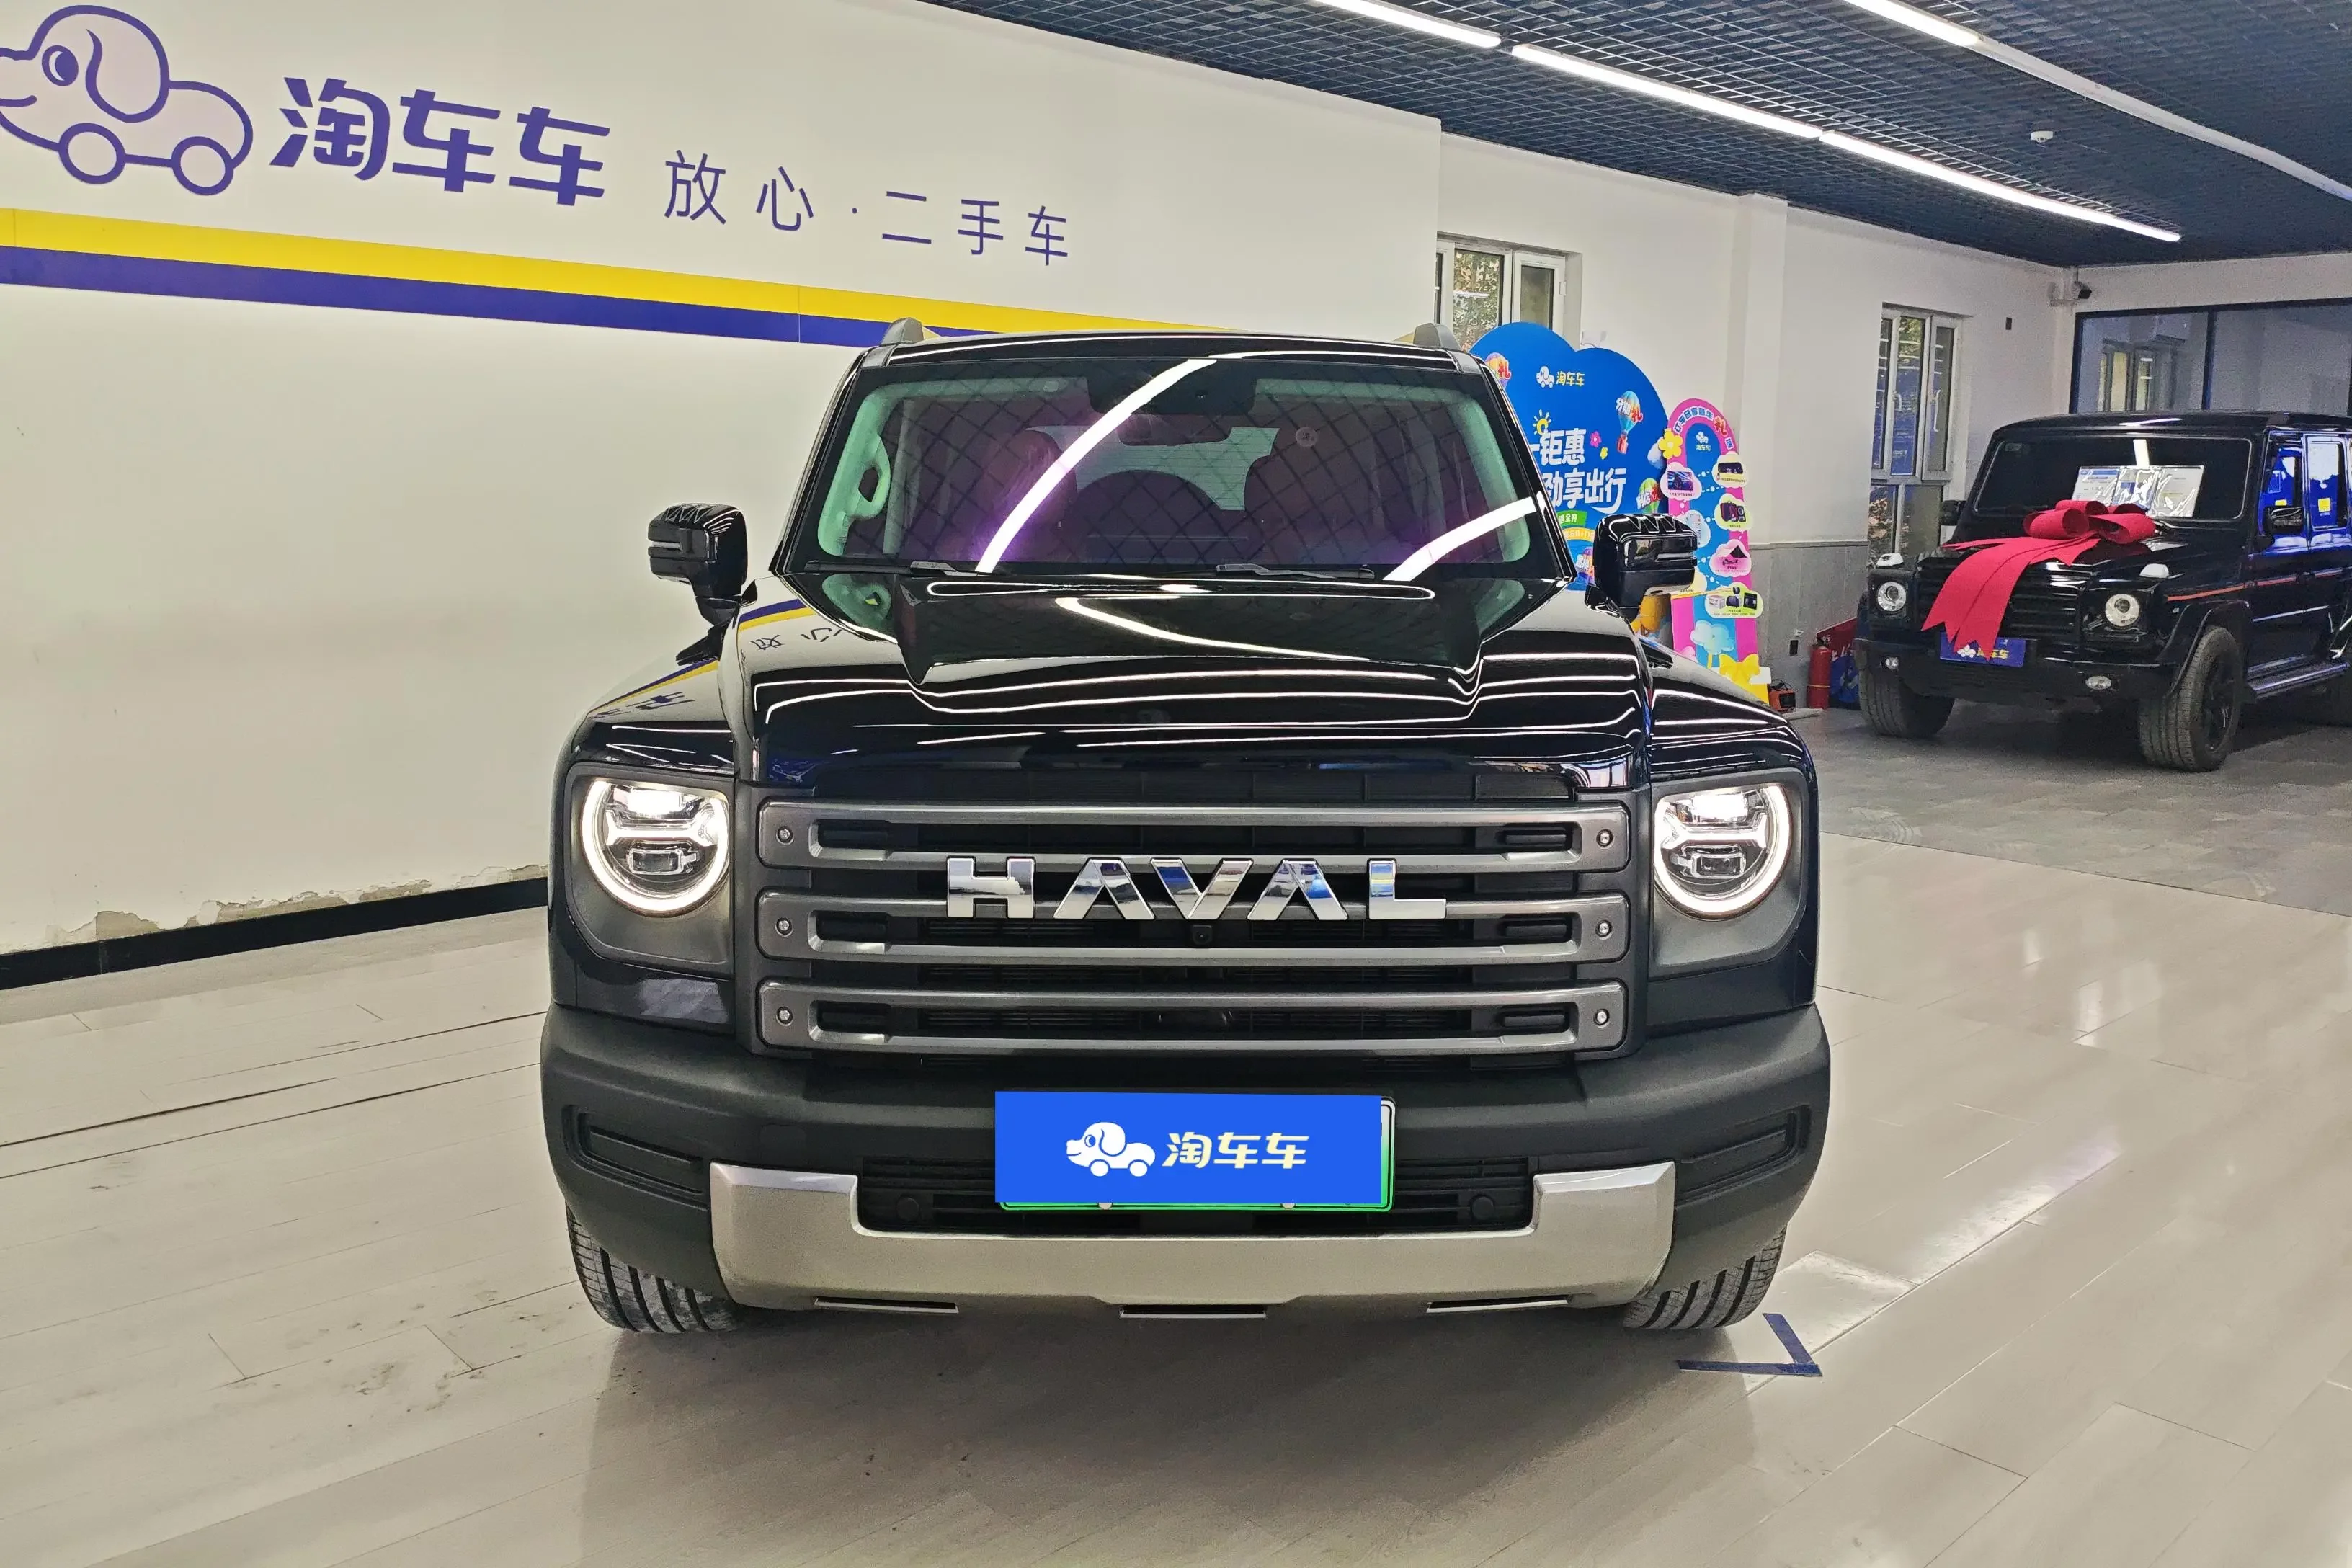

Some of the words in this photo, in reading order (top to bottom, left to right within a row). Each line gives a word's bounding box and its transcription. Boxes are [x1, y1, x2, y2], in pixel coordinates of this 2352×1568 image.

[270, 77, 610, 206] 淘车车
[1556, 370, 1586, 387] 淘车车
[947, 857, 1448, 921] HAVAL
